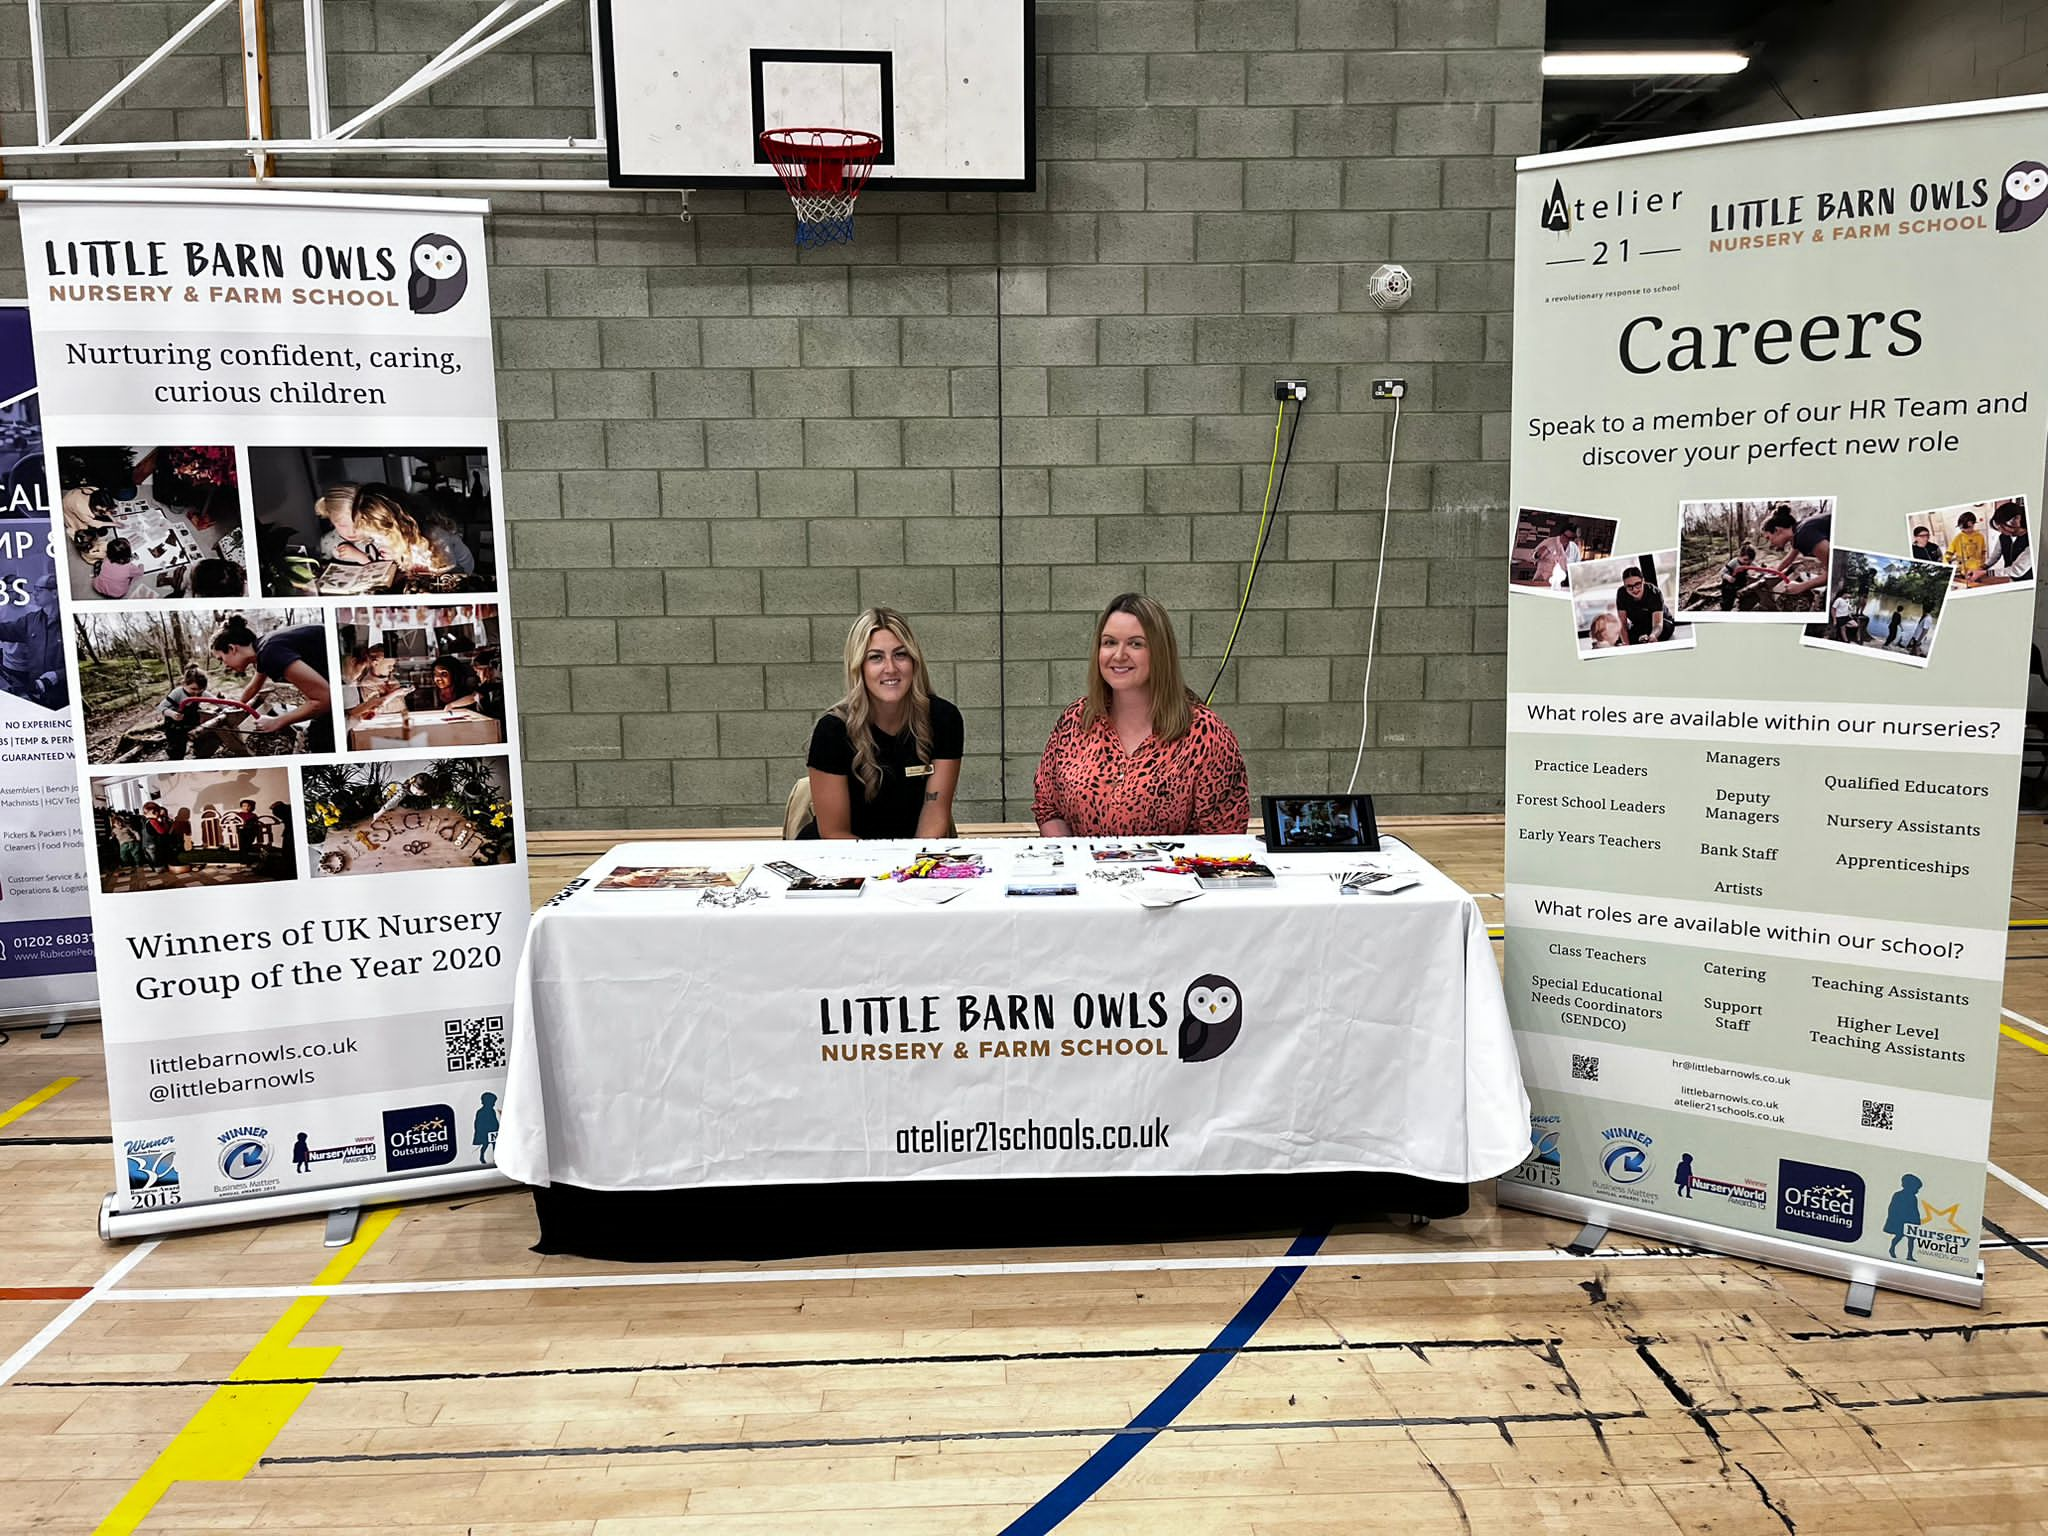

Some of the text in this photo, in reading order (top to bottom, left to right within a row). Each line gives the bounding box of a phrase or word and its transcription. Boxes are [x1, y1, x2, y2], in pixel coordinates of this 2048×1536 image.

[1712, 179, 1988, 232] LITTLE BARN OWLS
[1710, 216, 1987, 252] NURSERY & FARM SCHOOL
[46, 240, 396, 281] LITTLE BARN OWLS
[1593, 239, 1628, 265] 21
[49, 285, 399, 306] NURSERY & FARM SCHOOL
[1552, 292, 1603, 302] revolutionary
[1606, 289, 1640, 297] response
[1654, 284, 1680, 293] school
[1620, 310, 1921, 374] Careers
[66, 343, 461, 374] Nurturing confident, caring,
[155, 381, 386, 404] curious children
[1529, 392, 2027, 441] Speak to a member of our HR Team and
[1583, 431, 1958, 467] discover your perfect new role
[1528, 705, 2000, 738] What roles are available within our nurseries?
[15, 736, 48, 745] TEMP &
[2, 752, 64, 762] GUARANTEED
[1535, 760, 1647, 776] Practice Leaders
[1706, 752, 1780, 768] Managers
[1825, 776, 1988, 796] Qualified Educators
[1517, 794, 1665, 814] Forest School Leaders
[1717, 789, 1770, 806] Deputy
[1706, 807, 1779, 824] Managers
[1827, 815, 1980, 836] Nursery Assistants
[1520, 829, 1660, 849] Early Years Teachers
[1701, 844, 1778, 860] Bank Staff
[1836, 854, 1969, 877] Apprenticeships
[1714, 882, 1762, 896] Artists
[126, 912, 502, 959] Winners of UK Nursery
[1535, 900, 1963, 959] What roles are available within our school?
[14, 936, 52, 948] 01202
[1549, 944, 1646, 965] Class Teachers
[136, 946, 500, 999] Group of the Year 2020
[1704, 962, 1766, 983] Catering
[1532, 975, 1662, 1001] Special Educational
[1812, 976, 1968, 1005] Teaching Assistants
[821, 992, 1167, 1036] LITTLE BARN OWLS
[1531, 992, 1662, 1020] Needs Coordinators
[1704, 998, 1762, 1015] Support
[1561, 1012, 1626, 1032] (SENDCO)
[1716, 1017, 1751, 1031] Staff
[1838, 1016, 1938, 1040] Higher Level
[151, 1038, 357, 1074] littlebarnowls.co.uk
[822, 1039, 1168, 1061] NURSERY & FARM SCHOOL
[1810, 1031, 1965, 1062] Teaching Assistants
[1673, 1059, 1790, 1085] hr@littlebarnowls.co.uk
[150, 1069, 314, 1102] @littlebarnowls
[1674, 1095, 1784, 1123] atelier21schools.co.uk
[1680, 1086, 1778, 1110] littlebarnowls.co.uk
[124, 1136, 175, 1154] Winner
[217, 1126, 268, 1144] WINNER
[391, 1126, 448, 1147] Ofsted
[897, 1117, 1169, 1153] atelier21schools.co.uk
[1601, 1127, 1653, 1147] WINNER
[392, 1143, 449, 1157] Outstanding
[1514, 1165, 1560, 1186] 2015
[132, 1192, 181, 1209] 2015
[1692, 1178, 1765, 1201] NurseryWorld
[1785, 1187, 1853, 1215] Ofsted
[1785, 1206, 1853, 1228] Outstanding
[1906, 1225, 1970, 1248] Nursery
[1917, 1238, 1958, 1254] World
